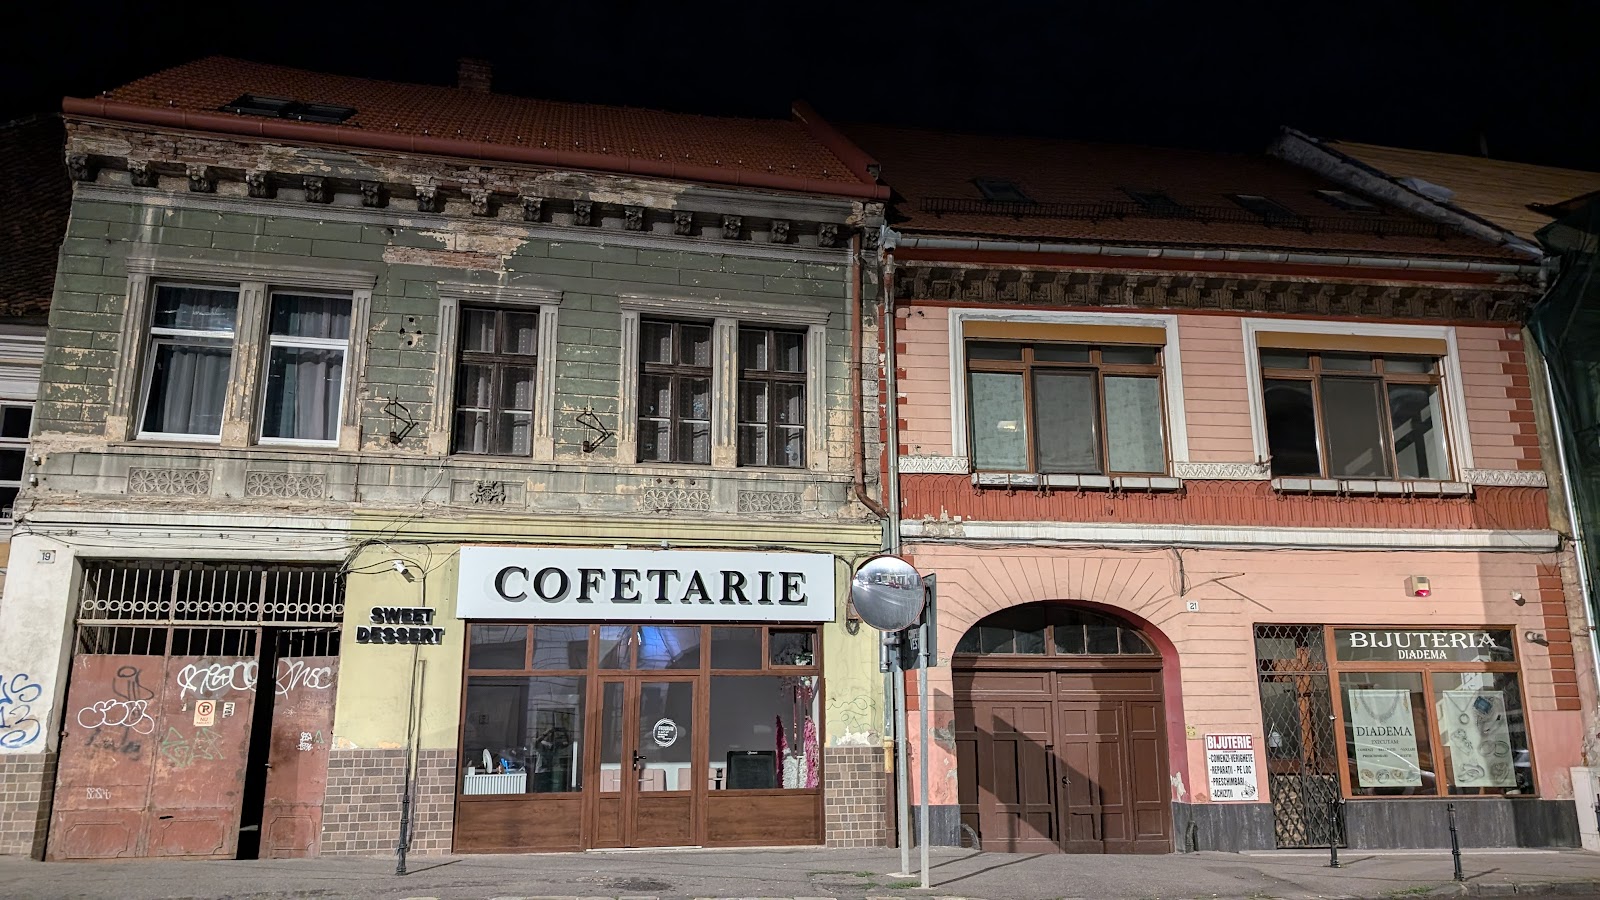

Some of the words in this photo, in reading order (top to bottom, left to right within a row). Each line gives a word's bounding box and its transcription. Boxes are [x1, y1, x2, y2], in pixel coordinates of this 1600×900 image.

[42, 552, 51, 561] 19
[494, 566, 808, 606] COFETARIE
[1190, 602, 1197, 610] 21
[370, 606, 436, 625] SWEET
[356, 626, 446, 645] DESSERT
[1349, 632, 1498, 650] BIJUTERIA
[1397, 649, 1447, 660] DIADEMA
[1356, 726, 1413, 737] DIADEMA
[1207, 736, 1252, 749] BIJUTERIE
[1243, 765, 1252, 774] LOC
